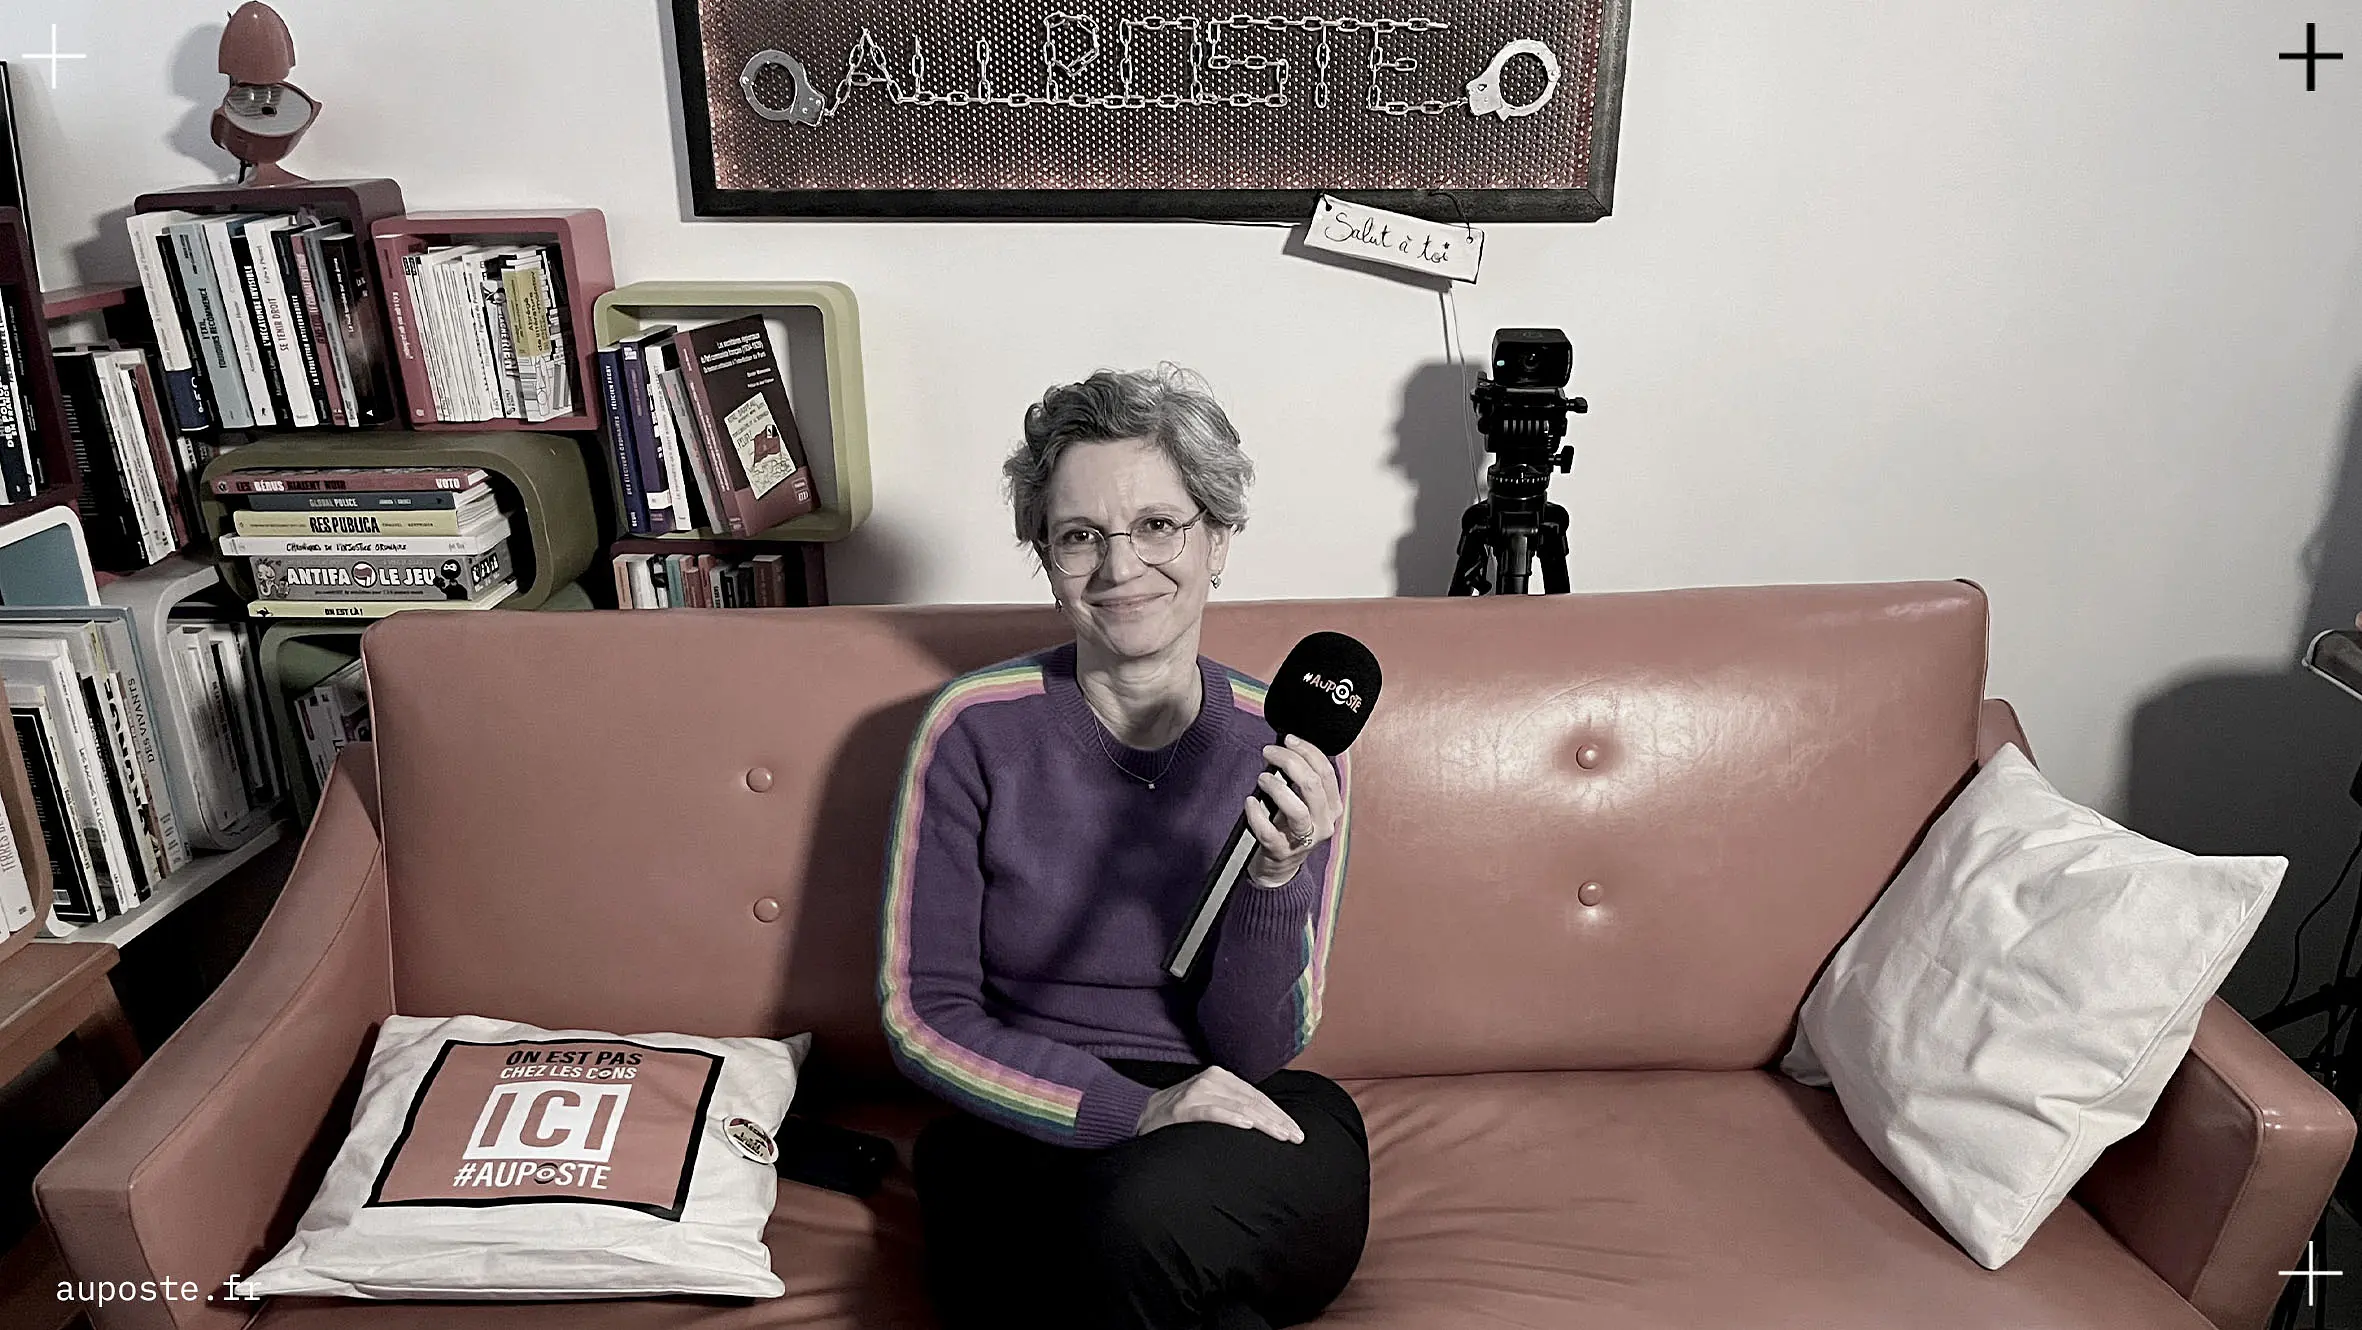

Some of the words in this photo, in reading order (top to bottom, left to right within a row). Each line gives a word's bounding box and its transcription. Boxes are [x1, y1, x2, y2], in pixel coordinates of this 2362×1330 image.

[1043, 12, 1450, 113] POSTE
[1324, 211, 1392, 249] Salut
[1399, 235, 1413, 254] à
[1416, 234, 1451, 264] toi
[243, 264, 259, 300] INVISIBLE
[267, 296, 280, 319] DROIT
[272, 319, 287, 342] TENIR
[278, 342, 289, 352] SE
[436, 478, 460, 489] VOTO
[334, 498, 358, 507] POLICE
[309, 517, 330, 533] RES
[332, 517, 380, 533] PUBLICA
[287, 568, 351, 586] ANTIFA
[378, 569, 401, 586] LE
[403, 568, 436, 586] JEU
[336, 608, 349, 616] EST
[125, 676, 149, 736] VIVANTS
[141, 736, 156, 763] DES
[506, 1051, 541, 1065] ON
[546, 1051, 592, 1065] EST
[595, 1052, 643, 1066] PAS
[500, 1065, 547, 1079] CHEZ
[549, 1065, 581, 1078] LES
[586, 1066, 637, 1079] CONS
[480, 1090, 617, 1150] ICI
[453, 1161, 612, 1190] #AUPOSTE
